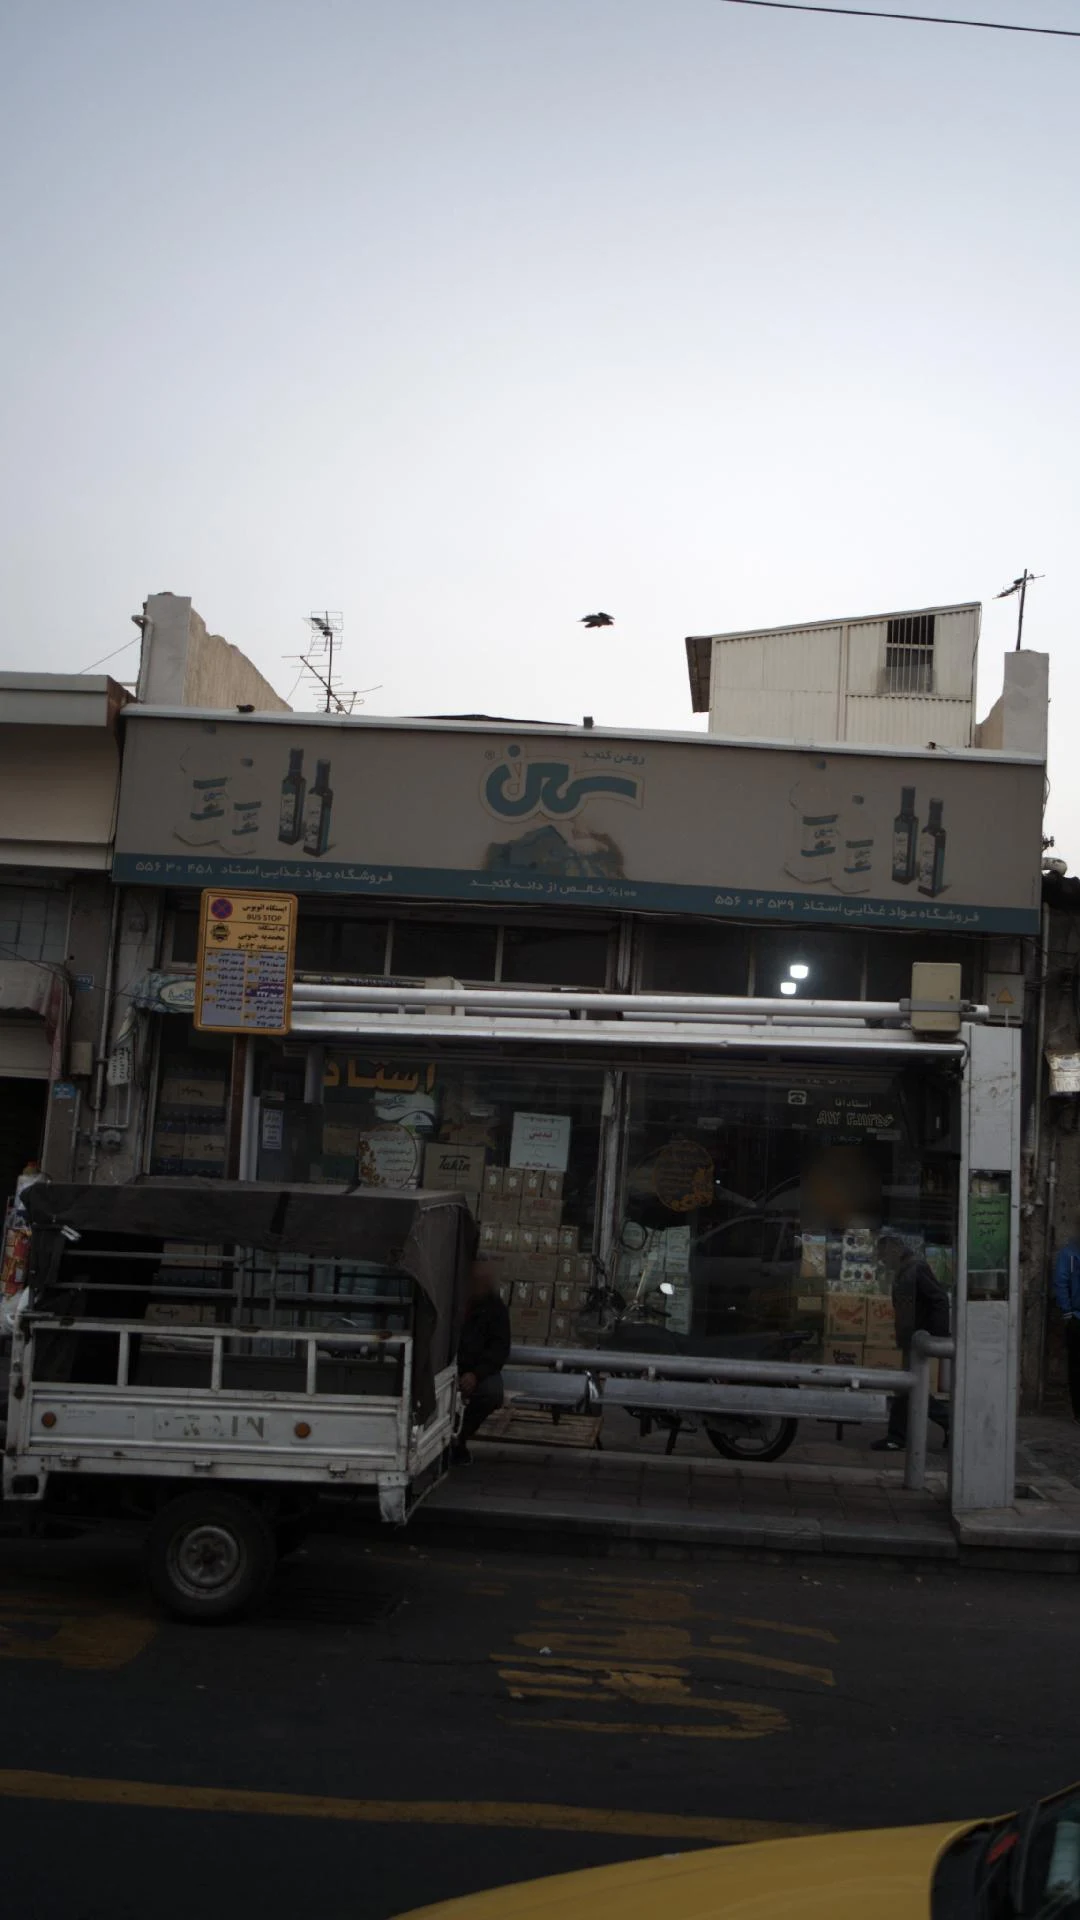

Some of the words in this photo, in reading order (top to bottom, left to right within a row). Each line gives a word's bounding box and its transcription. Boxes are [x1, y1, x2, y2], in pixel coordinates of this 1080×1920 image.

[613, 751, 645, 765] روغن
[219, 863, 259, 875] استاد
[260, 864, 301, 879] غذایی
[304, 868, 332, 881] مواد
[334, 868, 393, 884] فروشگاه
[469, 877, 512, 891] کنجد
[546, 881, 557, 893] از
[559, 882, 604, 894] خالص
[844, 903, 885, 917] غذایی
[888, 906, 917, 920] مواد
[919, 907, 980, 924] فروشگاه
[263, 914, 282, 922] STOP
[321, 1057, 437, 1093] استاد
